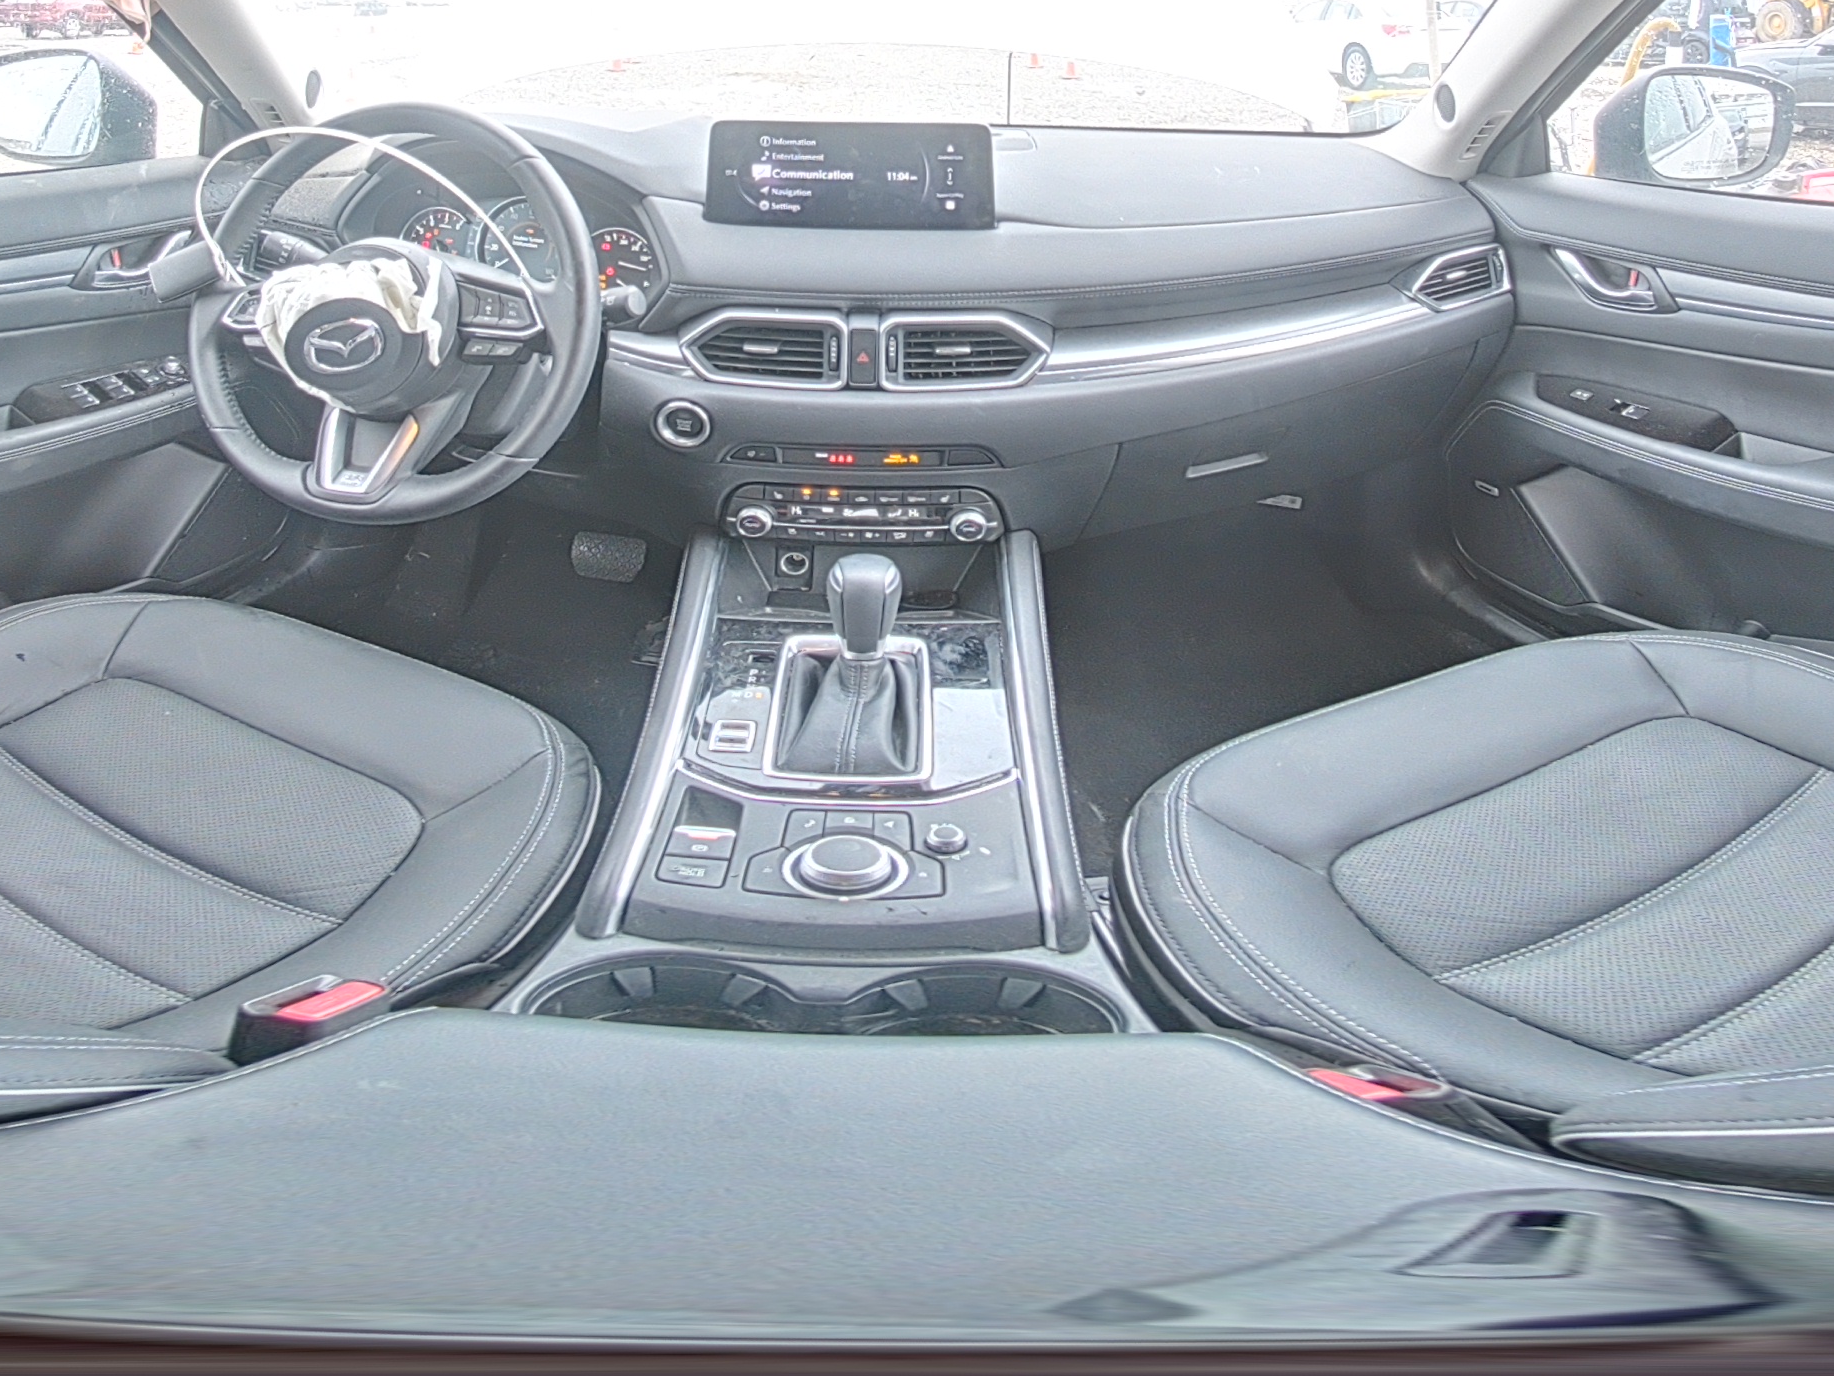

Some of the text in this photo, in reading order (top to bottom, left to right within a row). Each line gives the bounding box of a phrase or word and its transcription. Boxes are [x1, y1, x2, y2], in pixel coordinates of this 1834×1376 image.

[772, 138, 817, 146] Information
[772, 152, 824, 162] Entertainment
[772, 169, 854, 180] Communication
[771, 188, 812, 197] Navigation
[771, 203, 801, 212] Settings
